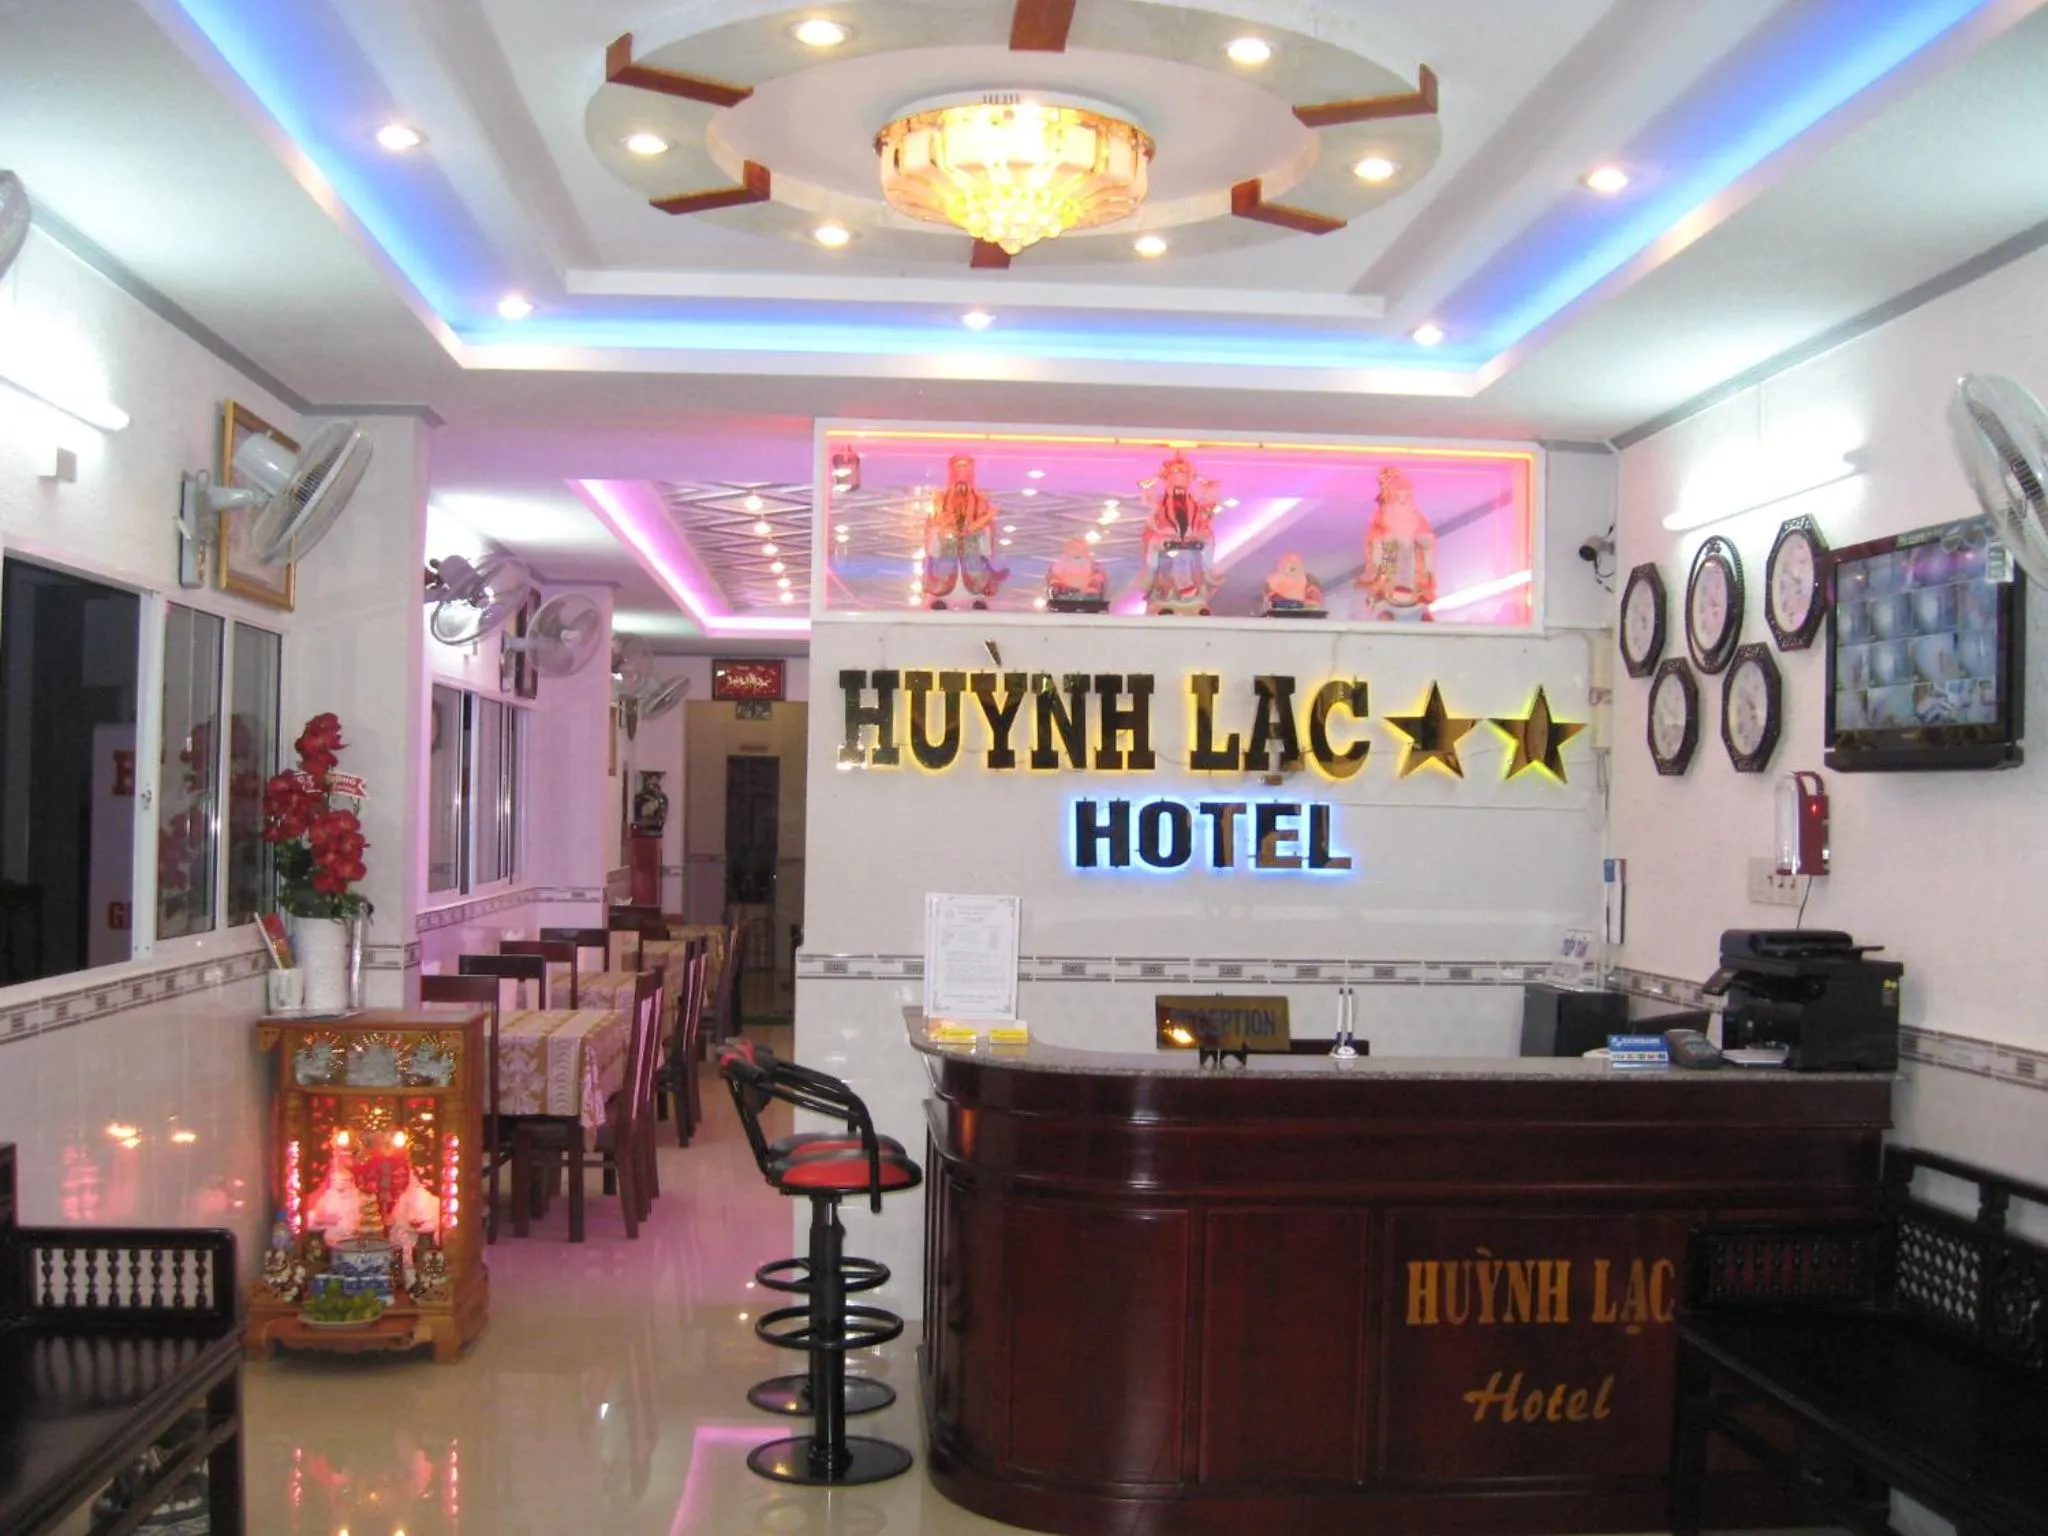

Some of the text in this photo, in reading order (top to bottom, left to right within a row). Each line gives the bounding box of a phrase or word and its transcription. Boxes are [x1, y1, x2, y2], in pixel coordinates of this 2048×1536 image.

[1075, 799, 1352, 870] HOTEL
[1406, 1246, 1675, 1335] HUỲNH LẠC
[1463, 1371, 1615, 1423] Hotel
